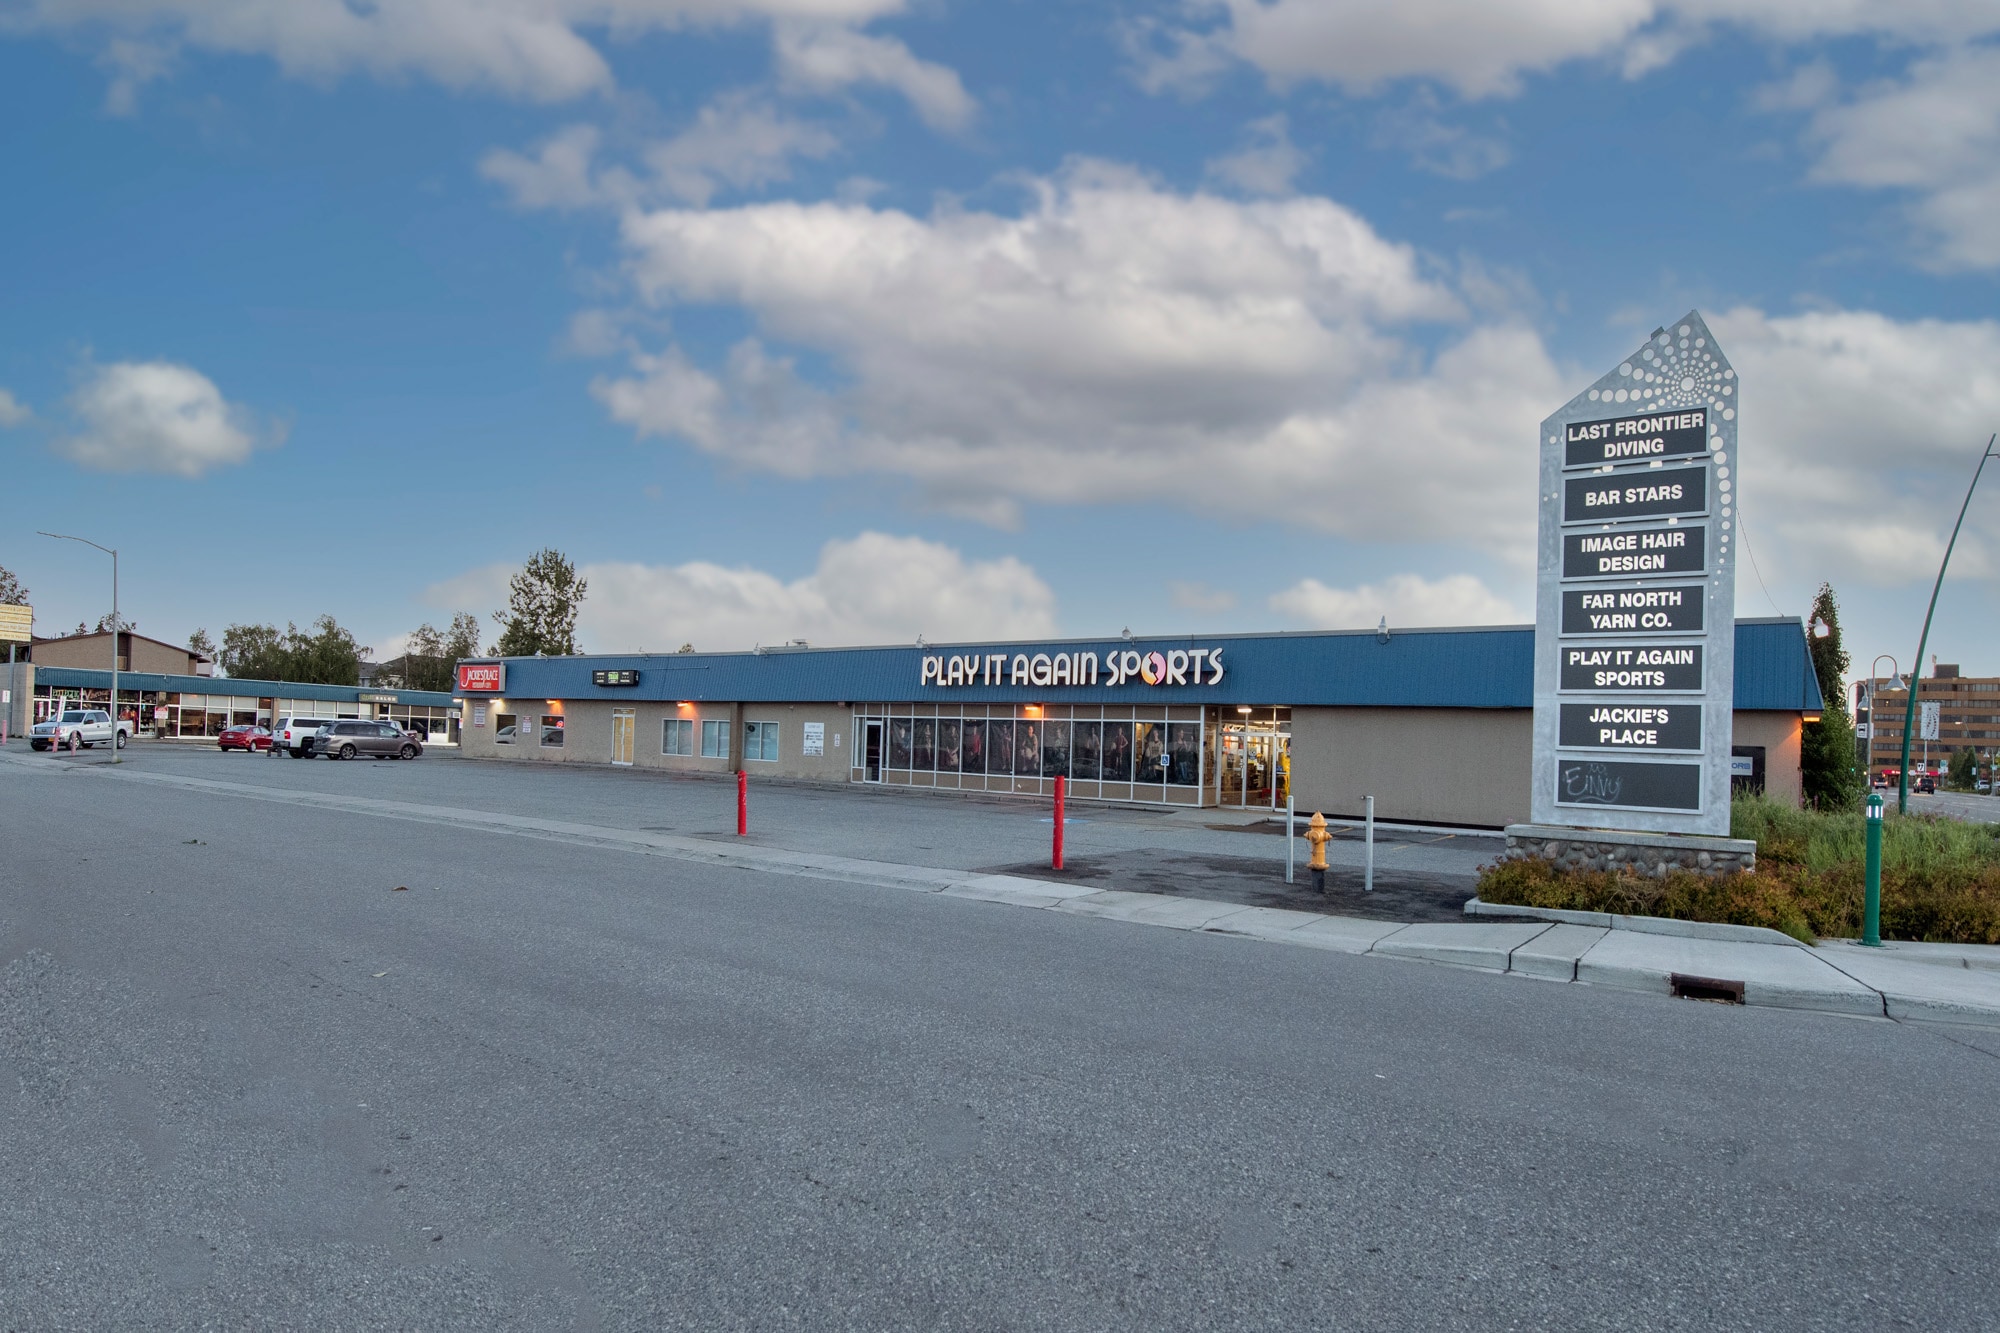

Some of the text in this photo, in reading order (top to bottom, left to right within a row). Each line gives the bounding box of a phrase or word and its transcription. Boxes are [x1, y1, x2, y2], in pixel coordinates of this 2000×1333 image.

[1568, 410, 1704, 442] LAST FRONTIER
[1604, 437, 1664, 459] DIVING
[1585, 484, 1683, 507] BAR STARS
[1581, 532, 1686, 553] IMAGE HAIR
[1599, 554, 1665, 573] DESIGN
[1582, 591, 1682, 609] FAR NORTH
[1589, 612, 1672, 629] YARN CO.
[921, 647, 1226, 686] PLAY IT AGAIN SPORTS
[1569, 649, 1694, 666] PLAY IT AGAIN
[1594, 670, 1665, 687] SPORTS
[1589, 708, 1669, 724] JACKIE'S
[1599, 728, 1658, 745] PLACE
